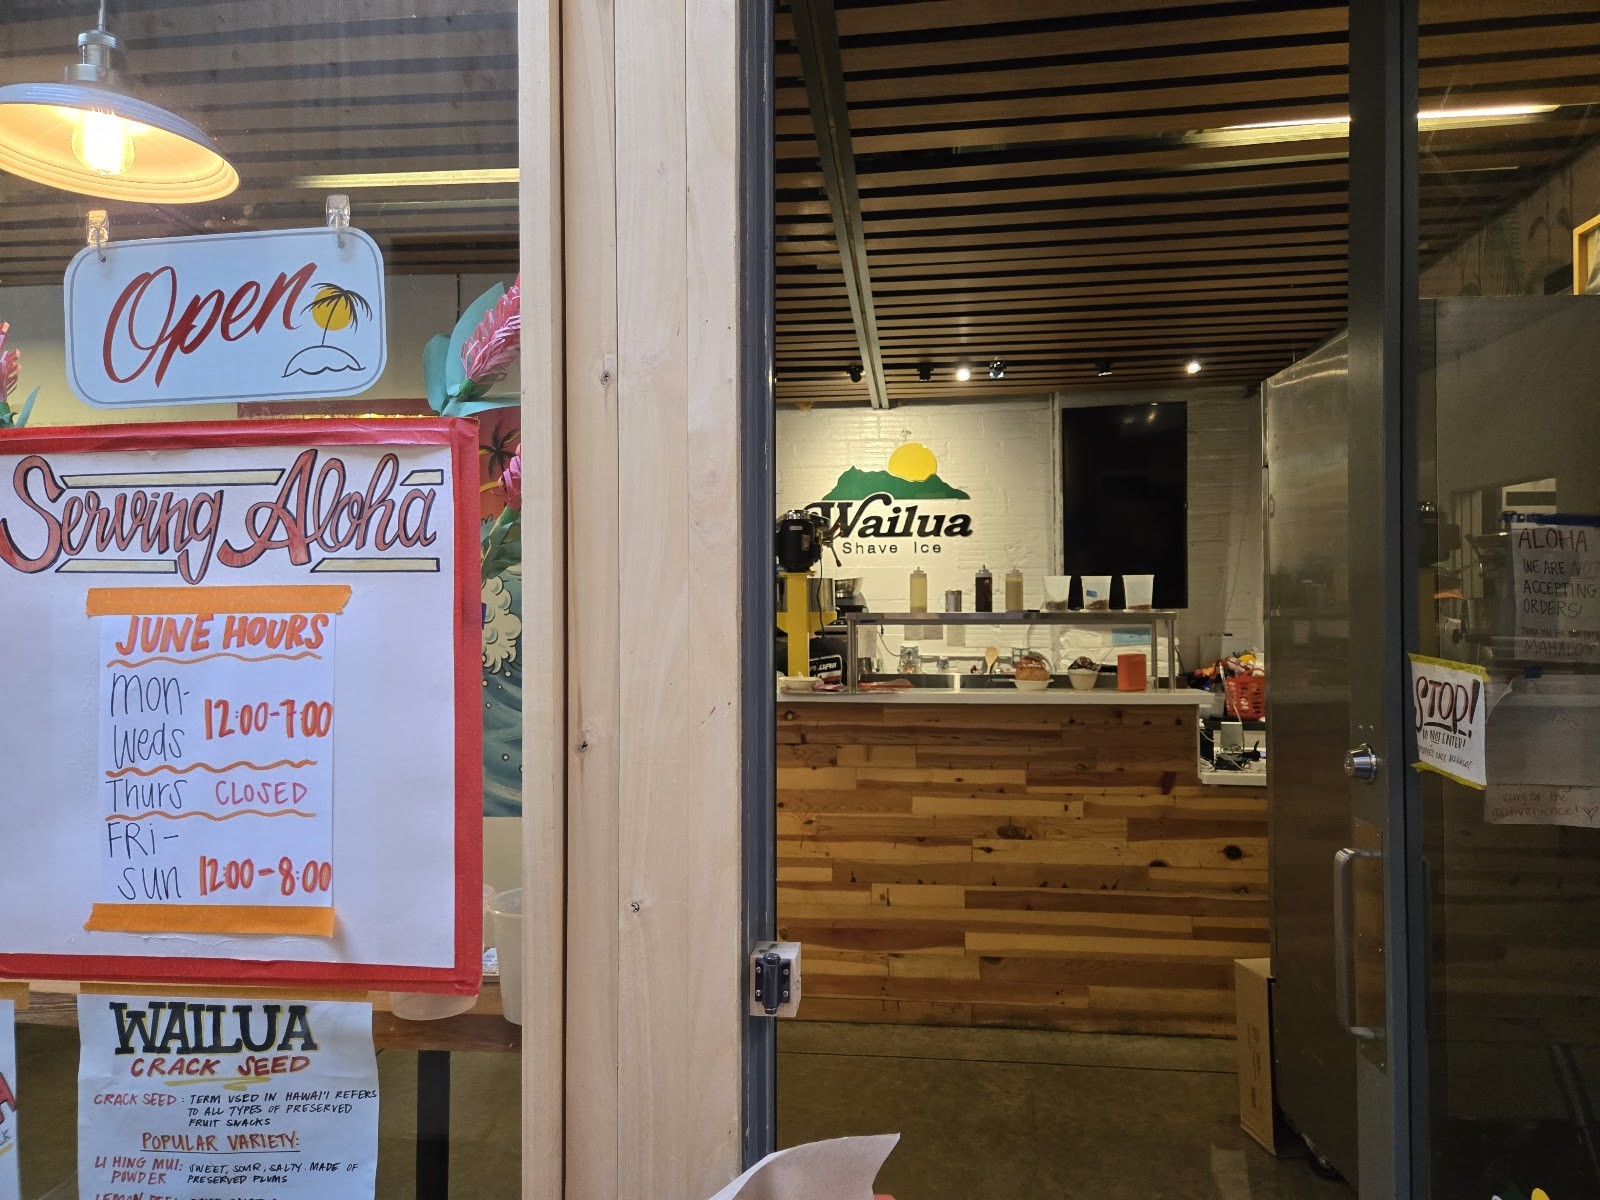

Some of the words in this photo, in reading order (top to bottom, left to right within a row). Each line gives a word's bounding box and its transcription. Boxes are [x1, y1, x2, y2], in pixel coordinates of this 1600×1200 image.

[103, 262, 318, 388] Open
[1, 455, 225, 585] Serving
[217, 449, 437, 567] Aloha
[802, 491, 973, 538] Wailua
[842, 542, 898, 554] Shave
[913, 541, 942, 554] Ice
[1518, 528, 1588, 552] ALOHA
[1522, 558, 1540, 573] WE
[1543, 560, 1565, 575] ARE
[1523, 580, 1597, 598] ACCEPTING
[115, 613, 214, 655] JUNE
[222, 614, 329, 650] HOURS
[1415, 676, 1481, 738] STOP!
[114, 723, 185, 769] Weds
[105, 779, 187, 812] Thurs
[215, 780, 308, 805] CLOSED
[109, 1001, 319, 1055] WAILUA
[130, 1057, 221, 1077] CRACK
[238, 1055, 310, 1076] SEED
[93, 1093, 139, 1105] CRACK
[190, 1094, 221, 1105] TERM
[228, 1094, 259, 1103] USED
[264, 1092, 277, 1102] IN
[335, 1089, 378, 1100] REFERS
[188, 1107, 199, 1117] TO
[204, 1106, 224, 1117] ALL
[228, 1105, 263, 1116] TYPES
[268, 1105, 280, 1114] OF
[286, 1104, 353, 1114] PRESERVED
[188, 1119, 221, 1127] FRUIT
[225, 1118, 271, 1127] SNACKS
[142, 1132, 218, 1152] POPULAR
[227, 1130, 299, 1151] VARIETY:
[94, 1156, 107, 1169] LI
[112, 1156, 147, 1169] HING
[310, 1161, 341, 1172] MADE
[346, 1163, 359, 1172] OF
[111, 1170, 167, 1185] POWDER
[187, 1175, 247, 1185] PRESERVED
[253, 1175, 288, 1184] PLUMS
